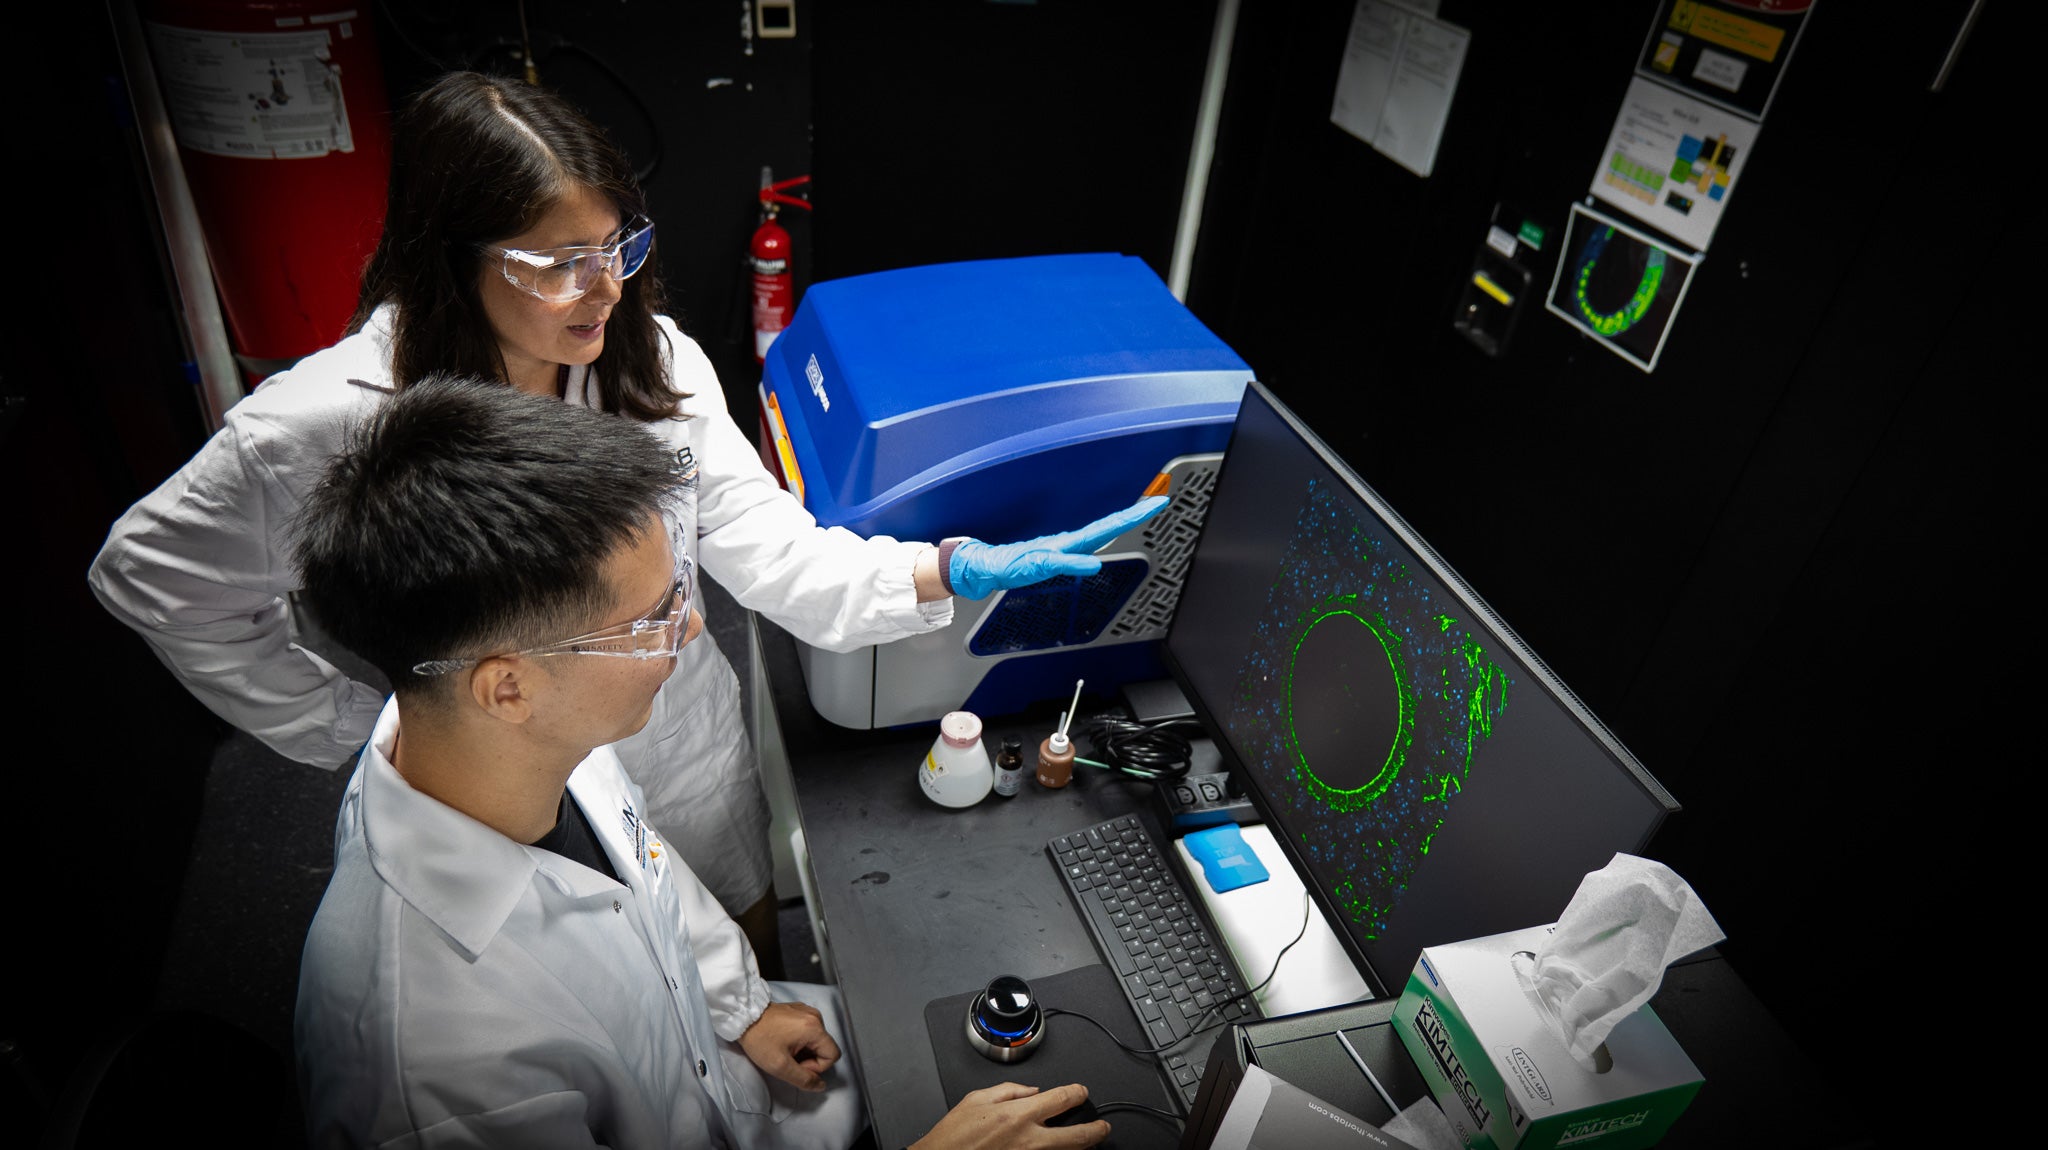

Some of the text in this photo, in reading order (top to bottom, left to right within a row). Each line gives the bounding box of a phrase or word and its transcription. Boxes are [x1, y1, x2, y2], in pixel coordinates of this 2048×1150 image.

[1418, 1003, 1490, 1123] KIMTECH
[1308, 1102, 1388, 1147] www.thorlabs.com
[1560, 1110, 1650, 1141] KIMTECH
